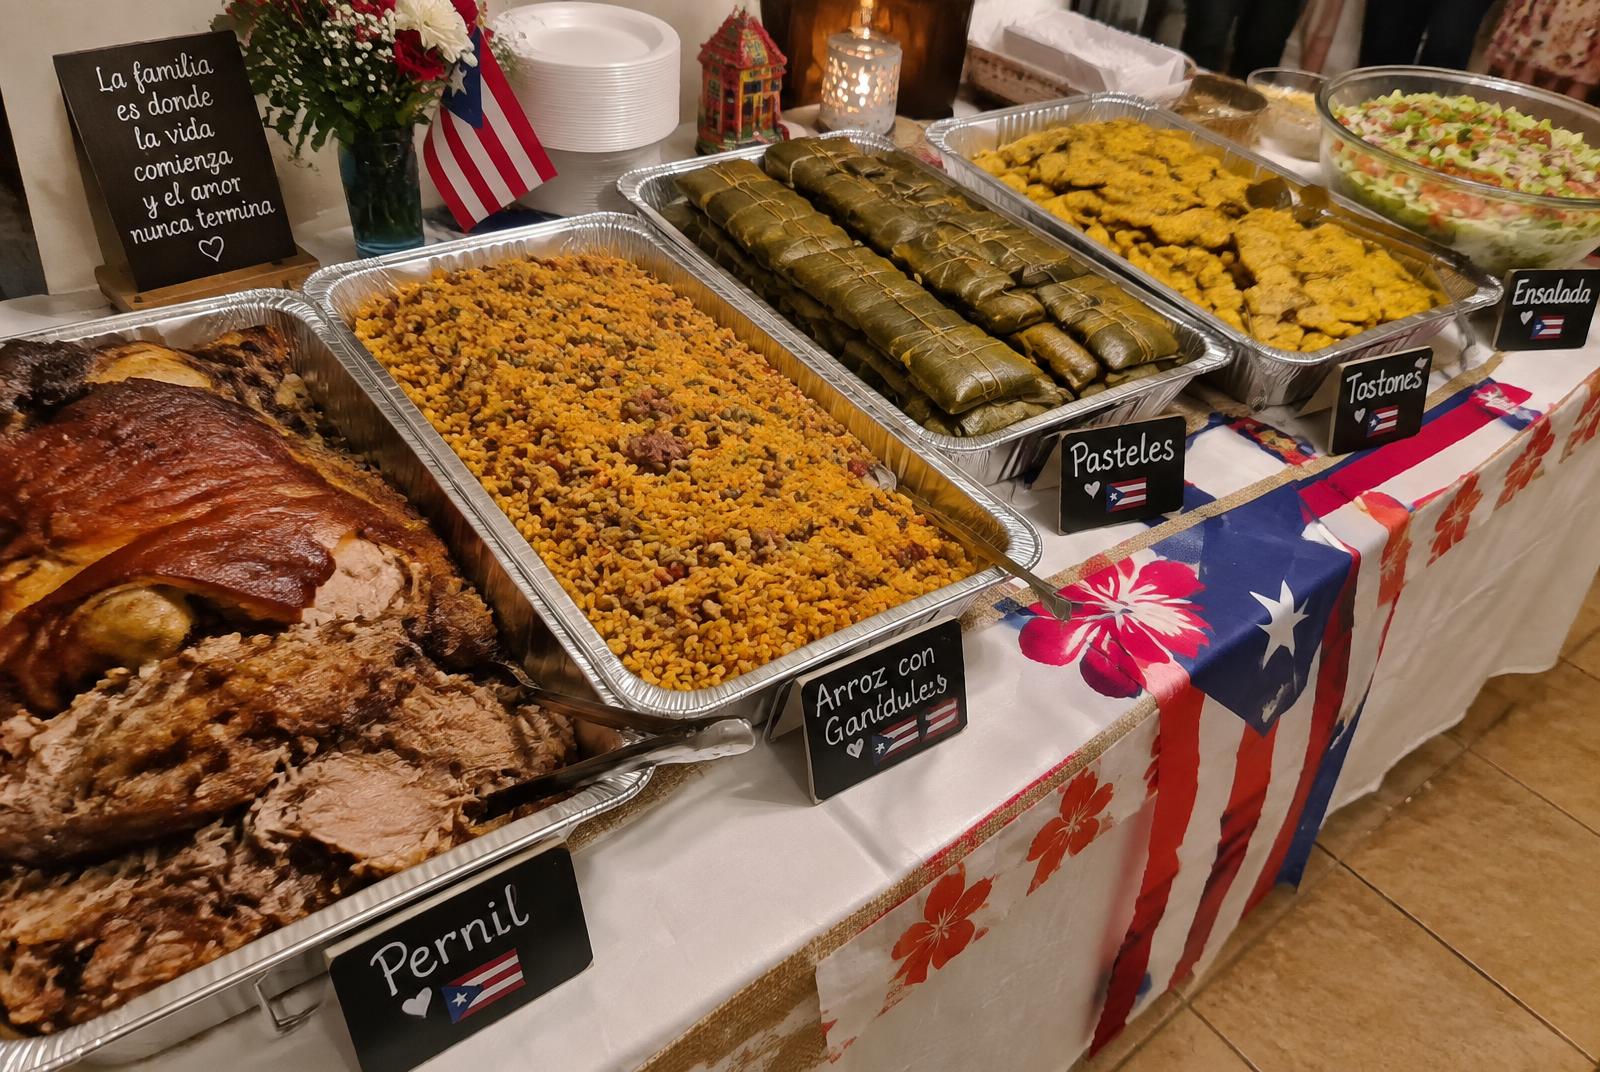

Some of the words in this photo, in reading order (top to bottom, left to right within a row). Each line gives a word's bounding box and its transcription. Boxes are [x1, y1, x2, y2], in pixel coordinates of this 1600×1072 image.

[95, 66, 128, 93] La
[133, 52, 214, 95] familia
[116, 102, 141, 122] es
[147, 84, 214, 116] donde
[133, 126, 161, 150] la
[164, 116, 216, 145] vida
[133, 150, 234, 182] comienza
[142, 194, 159, 219] y
[164, 181, 185, 207] el
[190, 177, 241, 201] amor
[130, 217, 195, 244] nunca
[196, 200, 276, 230] termina
[1512, 278, 1592, 306] Ensalada
[1346, 368, 1423, 404] Tostones
[1070, 432, 1175, 478] Pasteles
[816, 666, 888, 718] Arroz
[899, 647, 935, 677] con
[369, 883, 530, 997] Pernil
